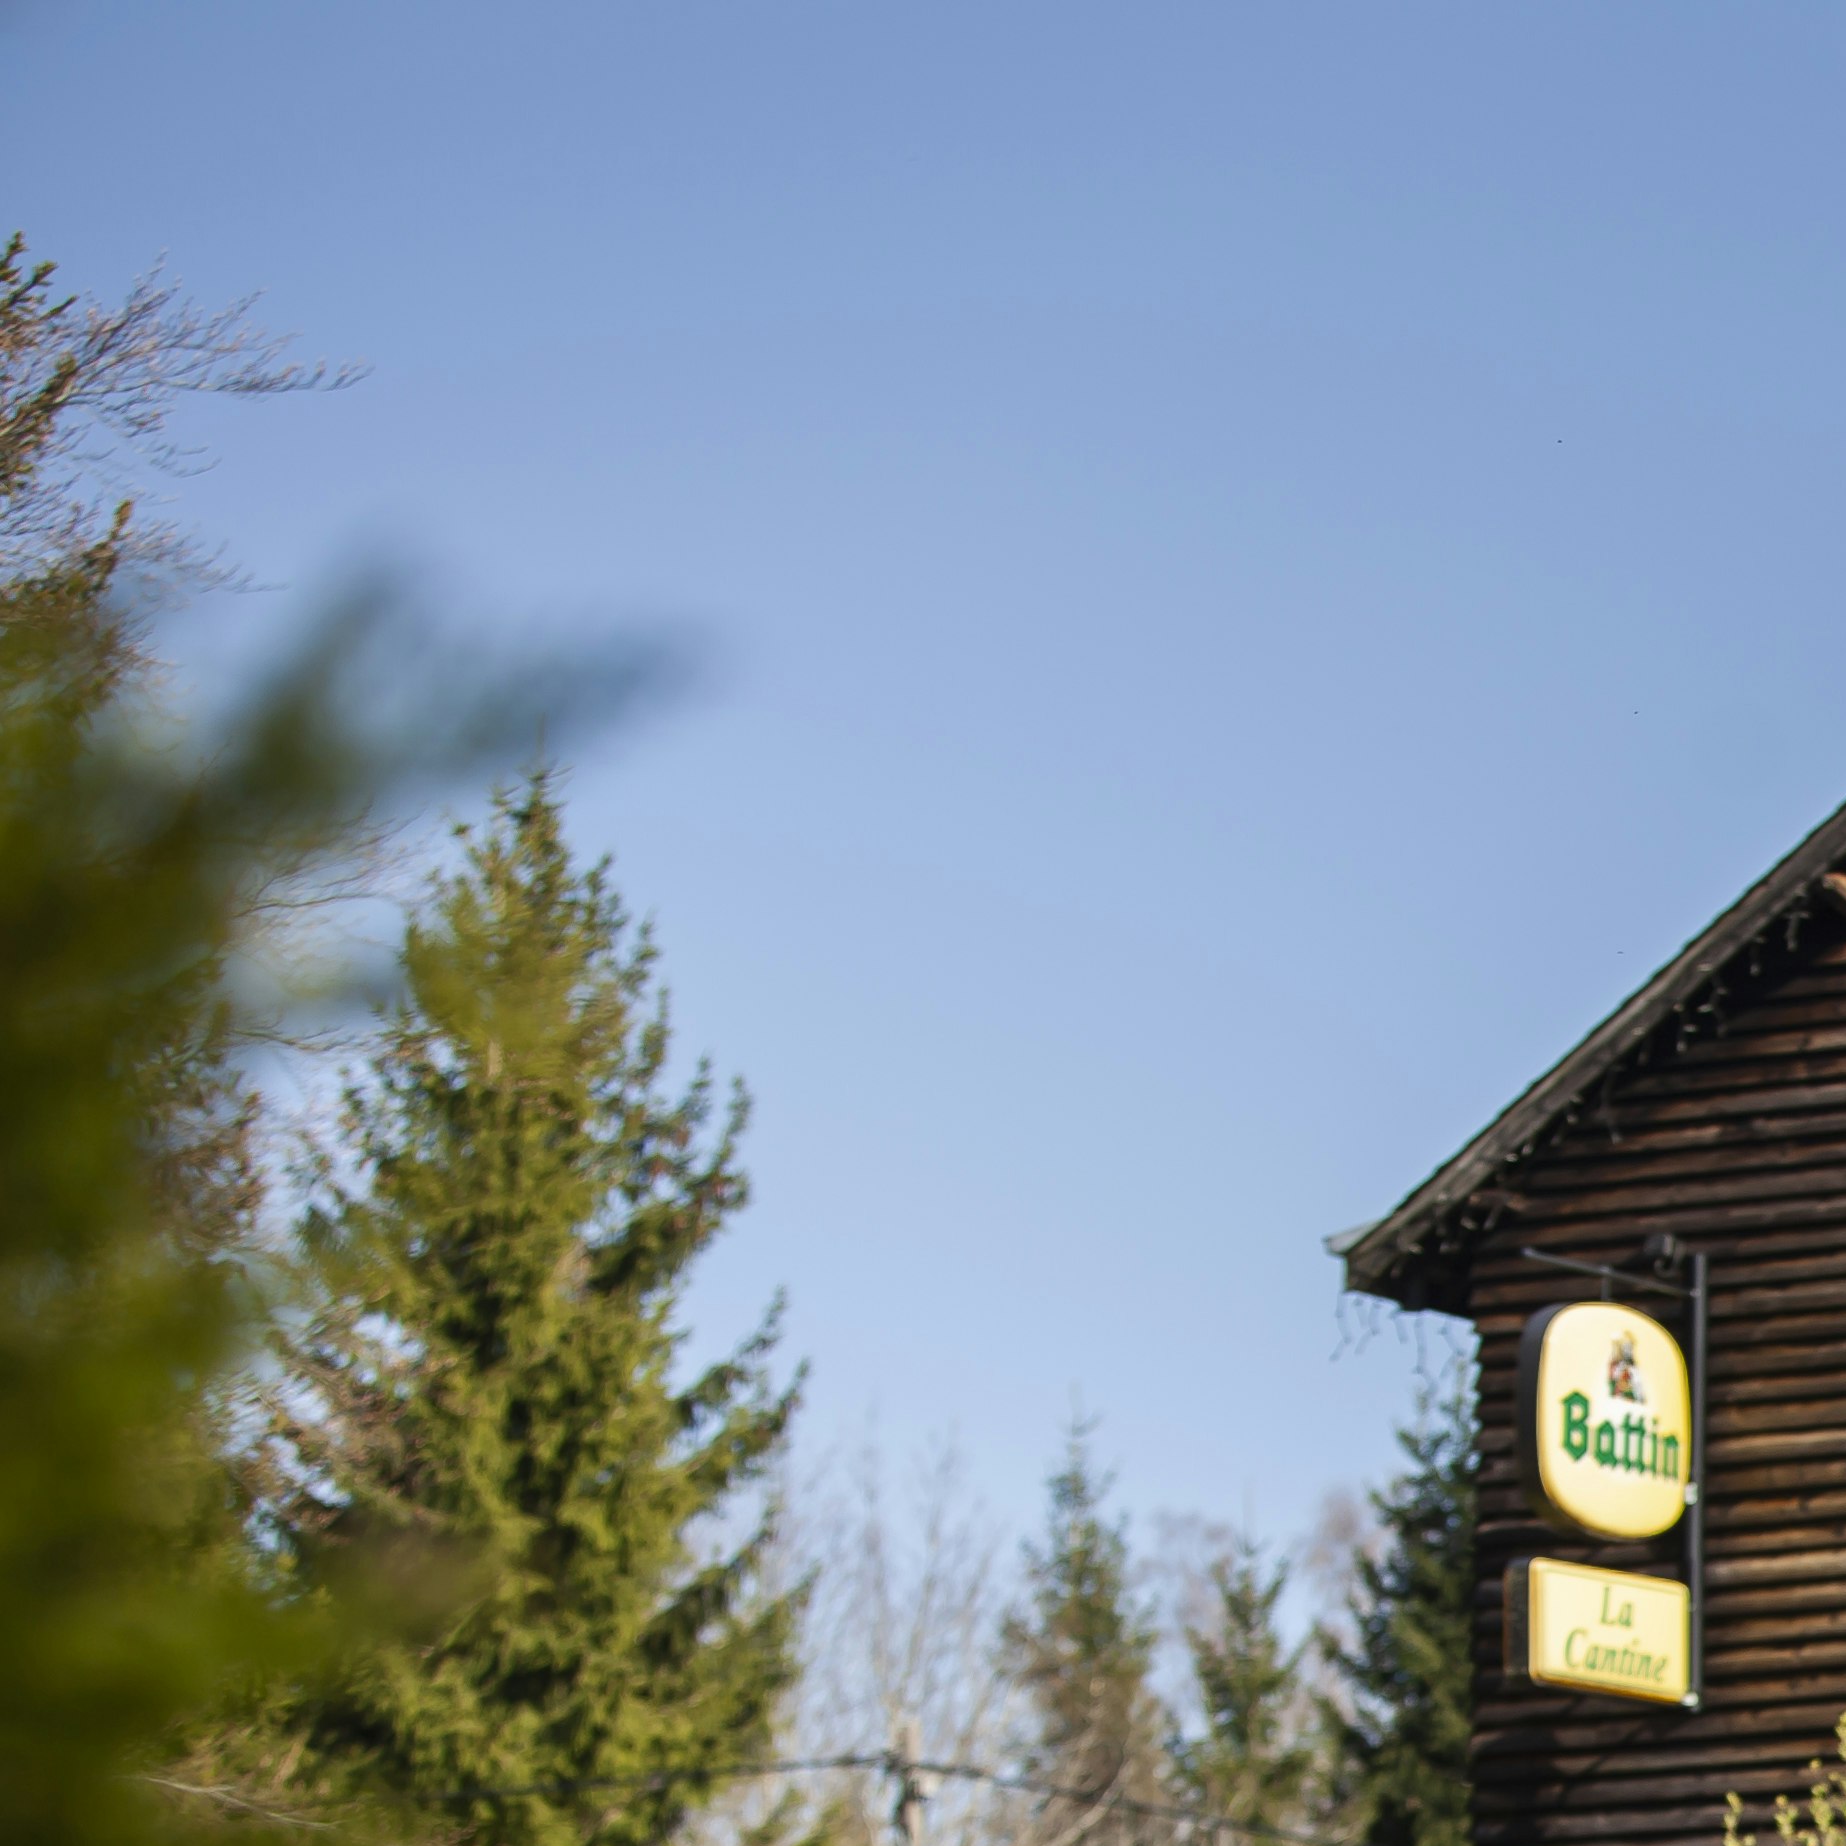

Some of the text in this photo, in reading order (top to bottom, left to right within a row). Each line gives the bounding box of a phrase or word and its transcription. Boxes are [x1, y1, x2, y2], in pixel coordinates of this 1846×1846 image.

[1560, 1390, 1680, 1481] Battin
[1600, 1584, 1634, 1628] La
[1563, 1628, 1668, 1684] Cantine
